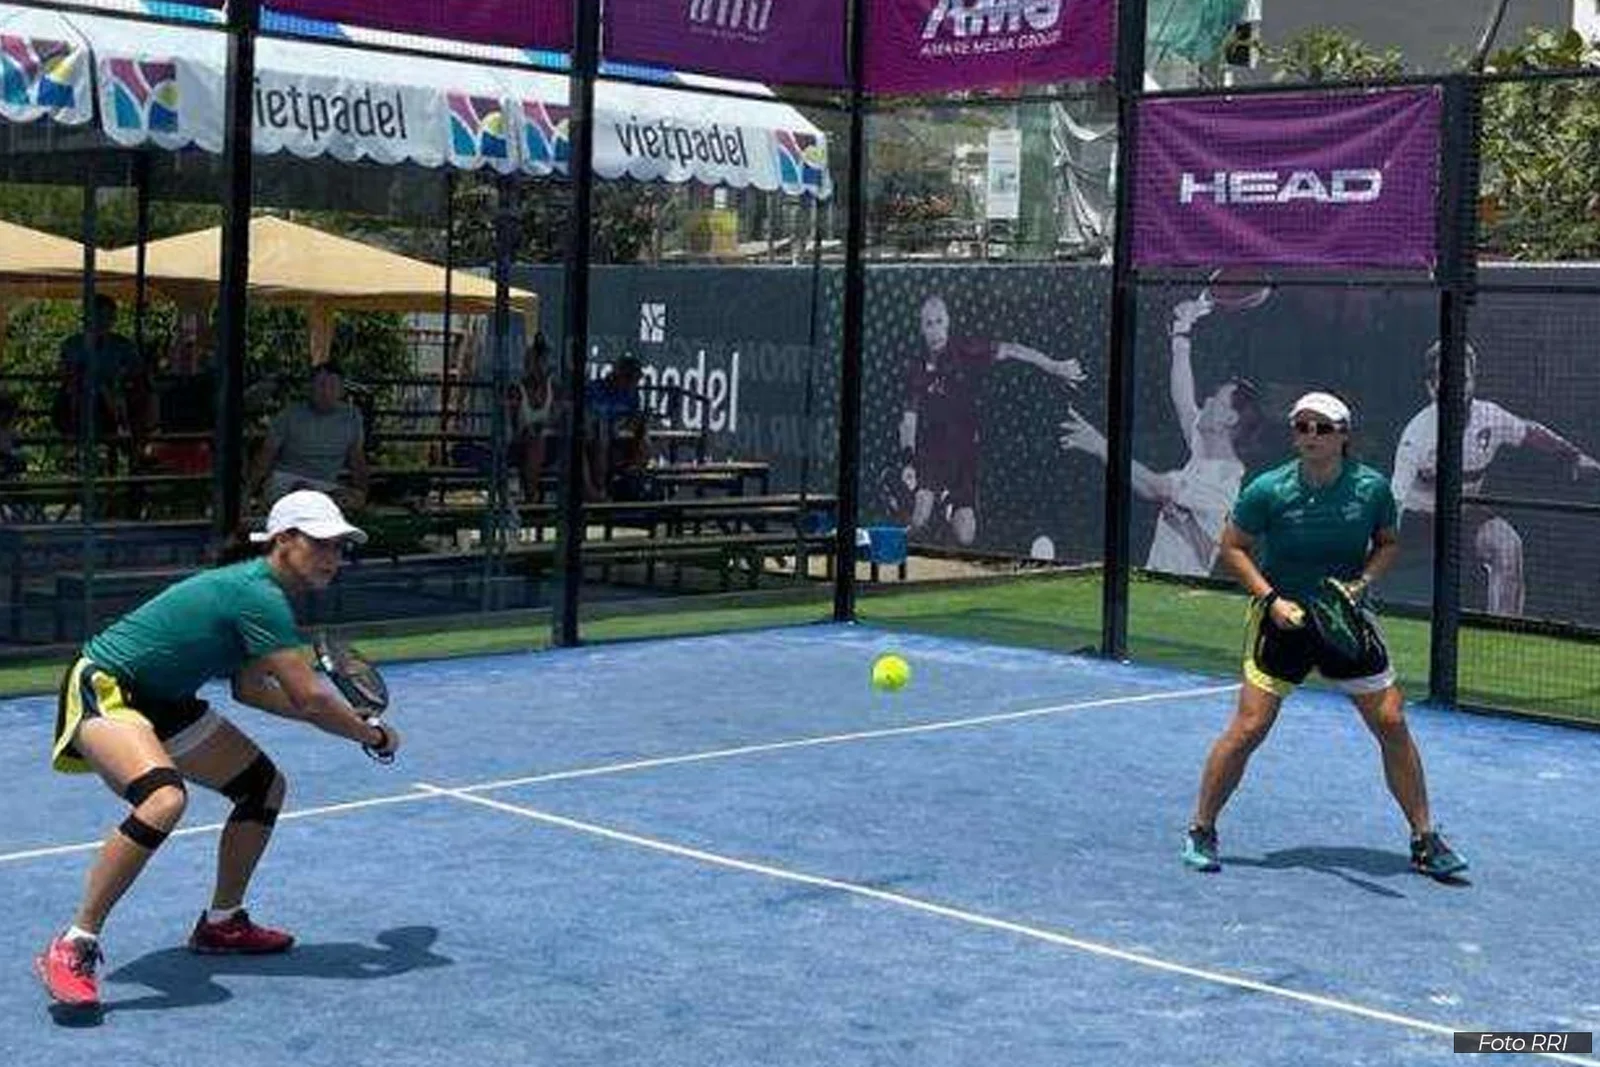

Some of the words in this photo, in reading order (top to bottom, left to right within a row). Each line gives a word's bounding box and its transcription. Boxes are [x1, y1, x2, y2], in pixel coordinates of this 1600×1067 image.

[254, 77, 407, 141] ietpadel
[615, 115, 749, 168] vietpadel
[1179, 168, 1382, 204] HEAD
